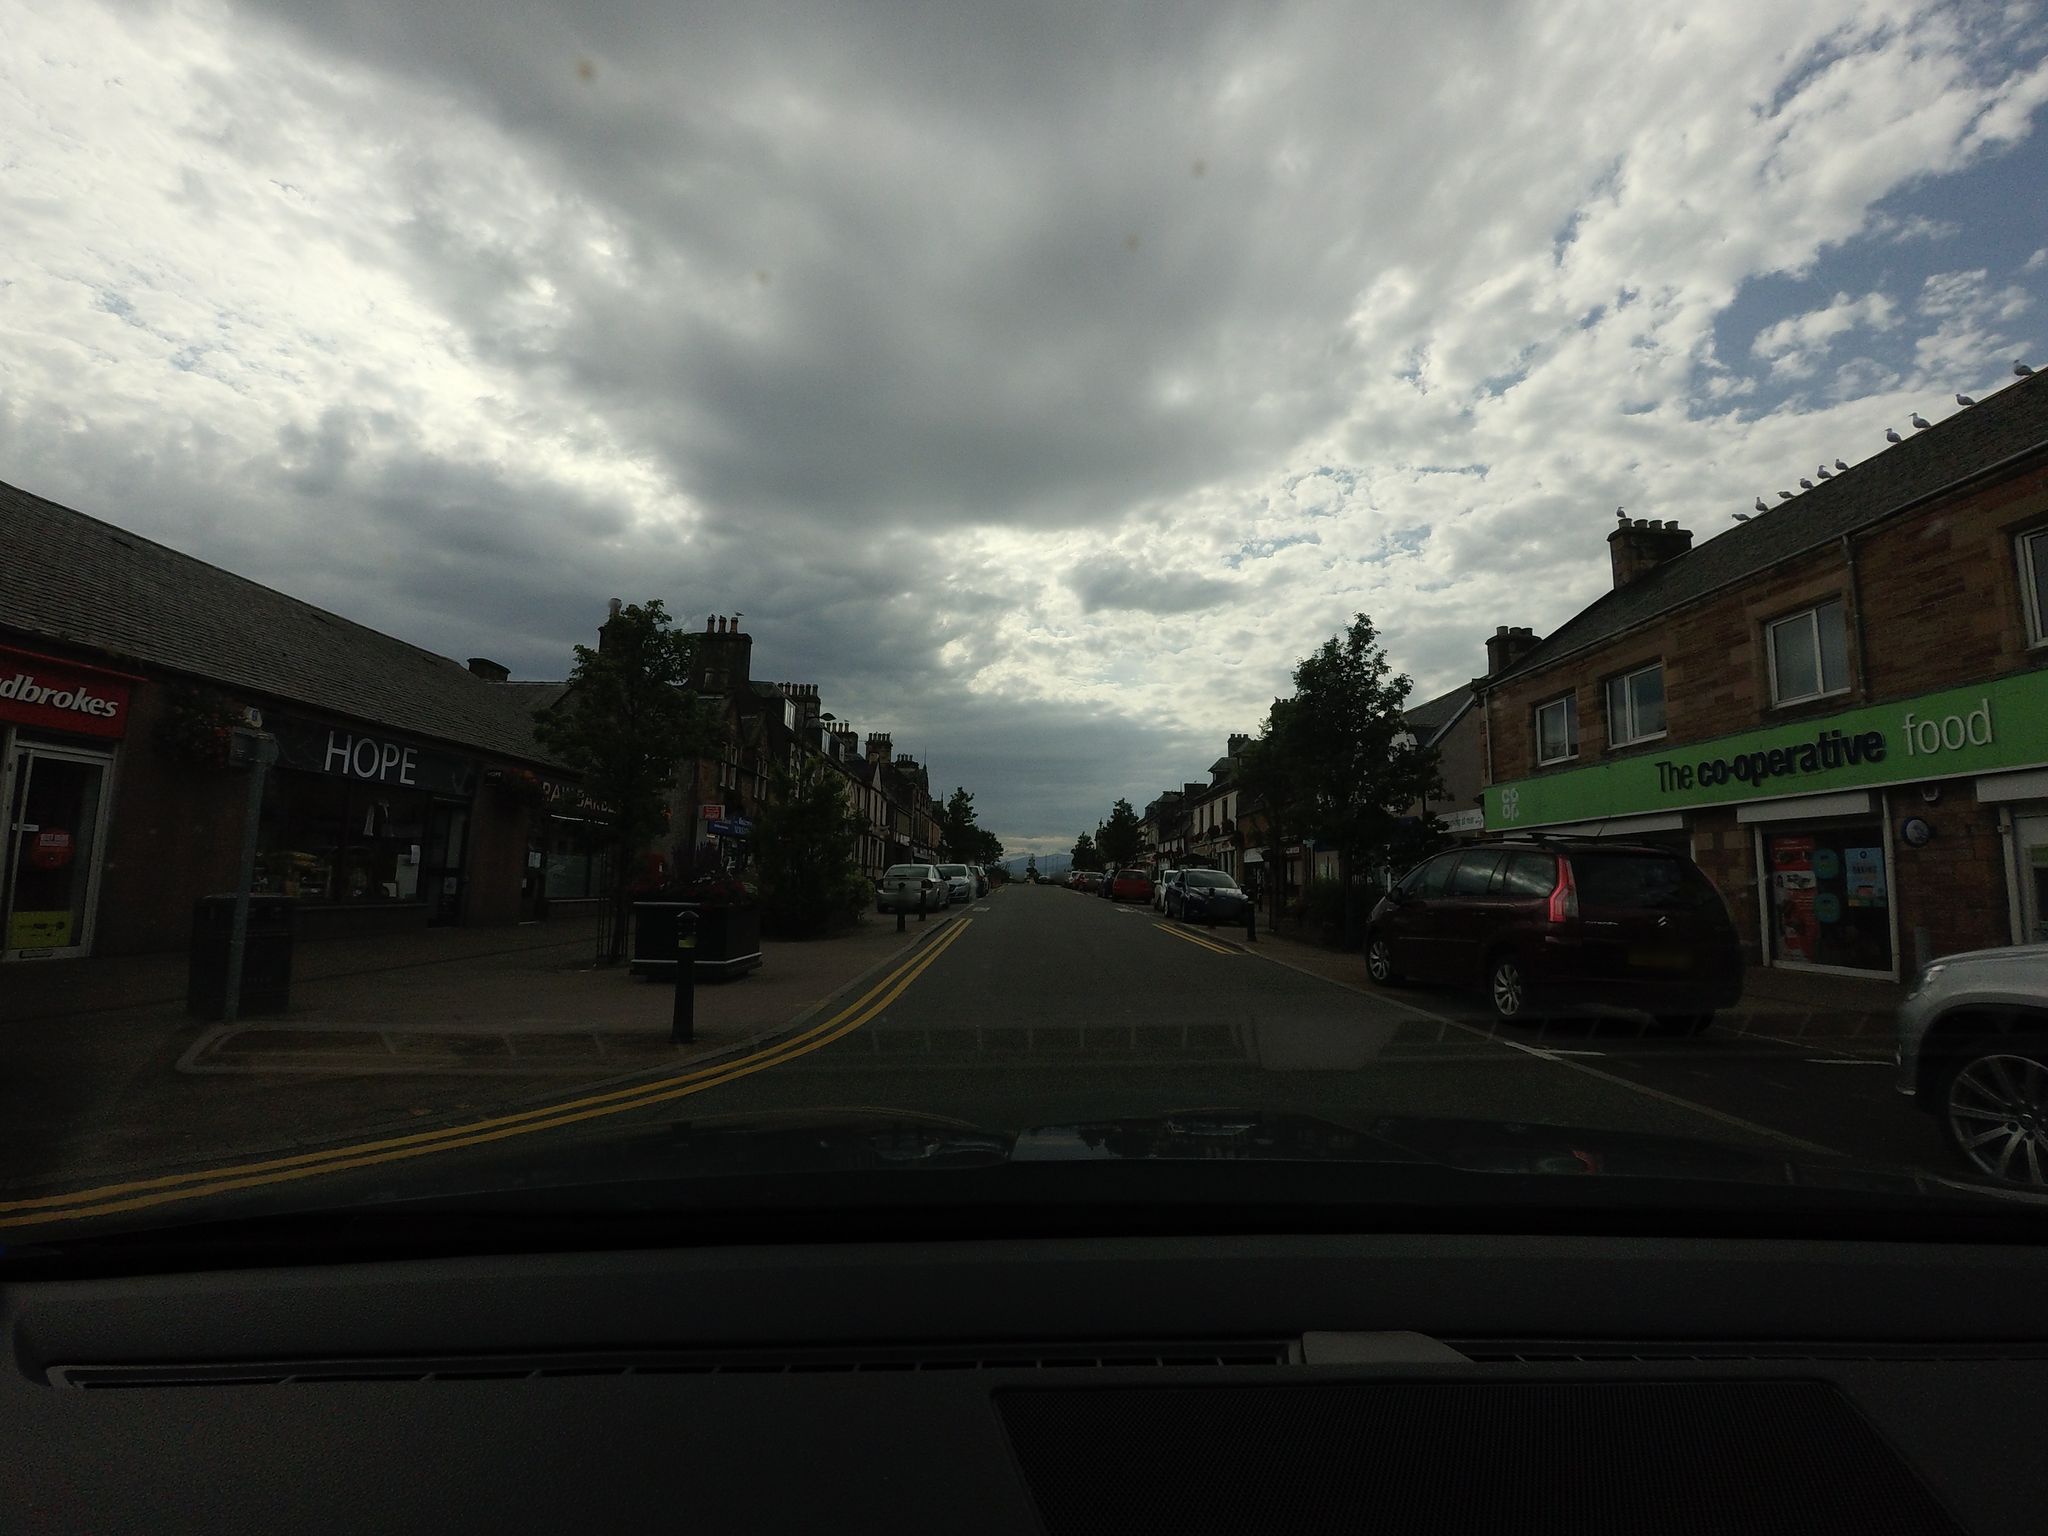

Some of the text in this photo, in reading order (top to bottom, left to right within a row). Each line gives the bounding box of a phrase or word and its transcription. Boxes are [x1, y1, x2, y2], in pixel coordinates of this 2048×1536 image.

[0, 673, 119, 718] dbrokes
[324, 729, 419, 785] HOPE
[1655, 698, 1994, 793] The co-operative food
